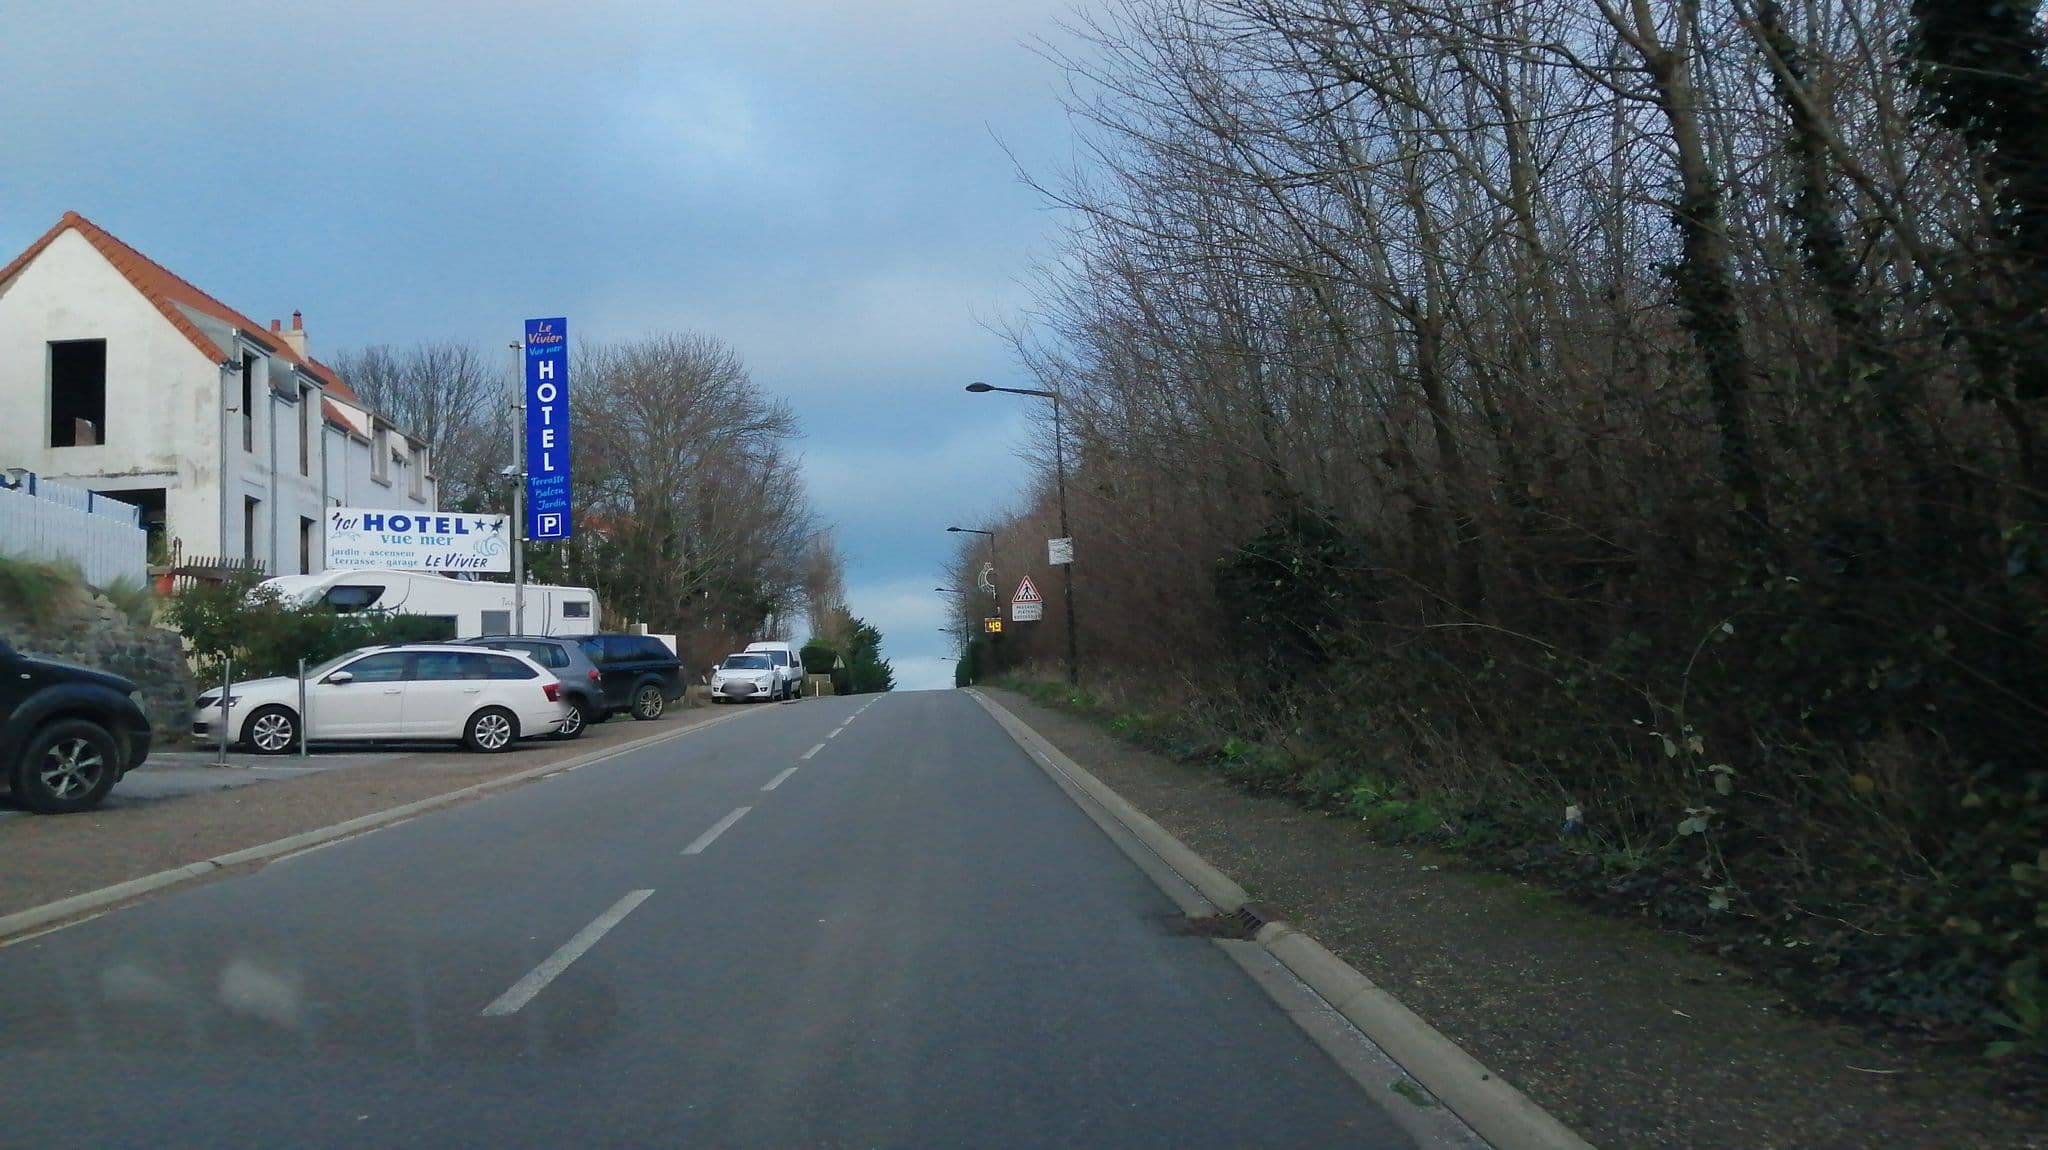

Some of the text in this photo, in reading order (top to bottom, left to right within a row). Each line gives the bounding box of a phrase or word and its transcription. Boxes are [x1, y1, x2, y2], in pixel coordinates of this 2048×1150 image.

[538, 321, 552, 333] Le
[528, 332, 563, 344] Vivier
[529, 345, 562, 357] Vue mer
[537, 360, 557, 471] HOTEL
[530, 475, 565, 487] Terrasse
[535, 487, 565, 498] Balcon
[536, 499, 567, 511] Jardin
[363, 513, 469, 535] HOTEL
[543, 517, 557, 533] P
[381, 534, 453, 546] vue mer
[331, 548, 416, 558] jardin ascenseur
[335, 558, 418, 568] terrasse garage
[988, 621, 1002, 632] 49
